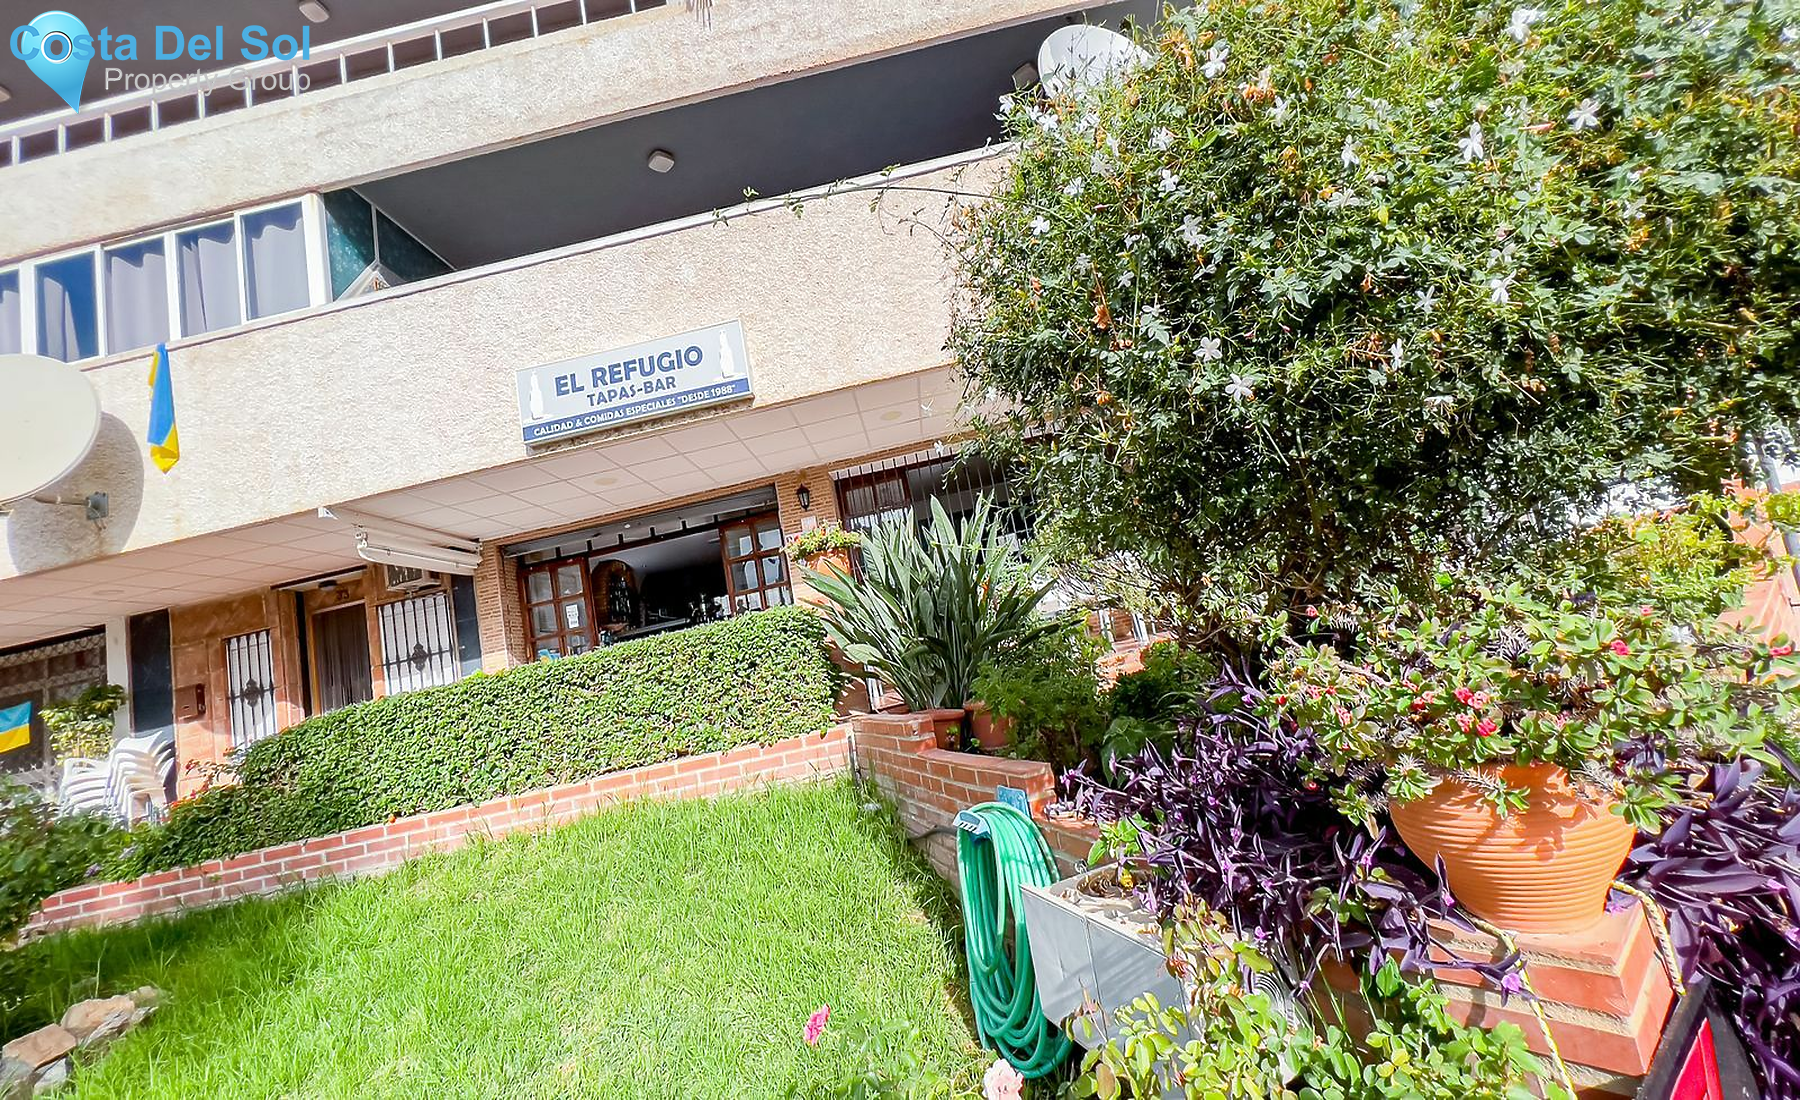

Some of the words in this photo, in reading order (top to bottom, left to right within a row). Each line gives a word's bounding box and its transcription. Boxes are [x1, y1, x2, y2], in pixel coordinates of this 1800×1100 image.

[554, 375, 585, 397] EL
[591, 345, 704, 388] REFUGIO
[587, 376, 677, 407] TAPAS-BAR
[533, 421, 574, 436] CALIDAD
[575, 418, 583, 427] &
[584, 409, 624, 425] COMIDAS
[626, 398, 676, 415] ESPECIALES
